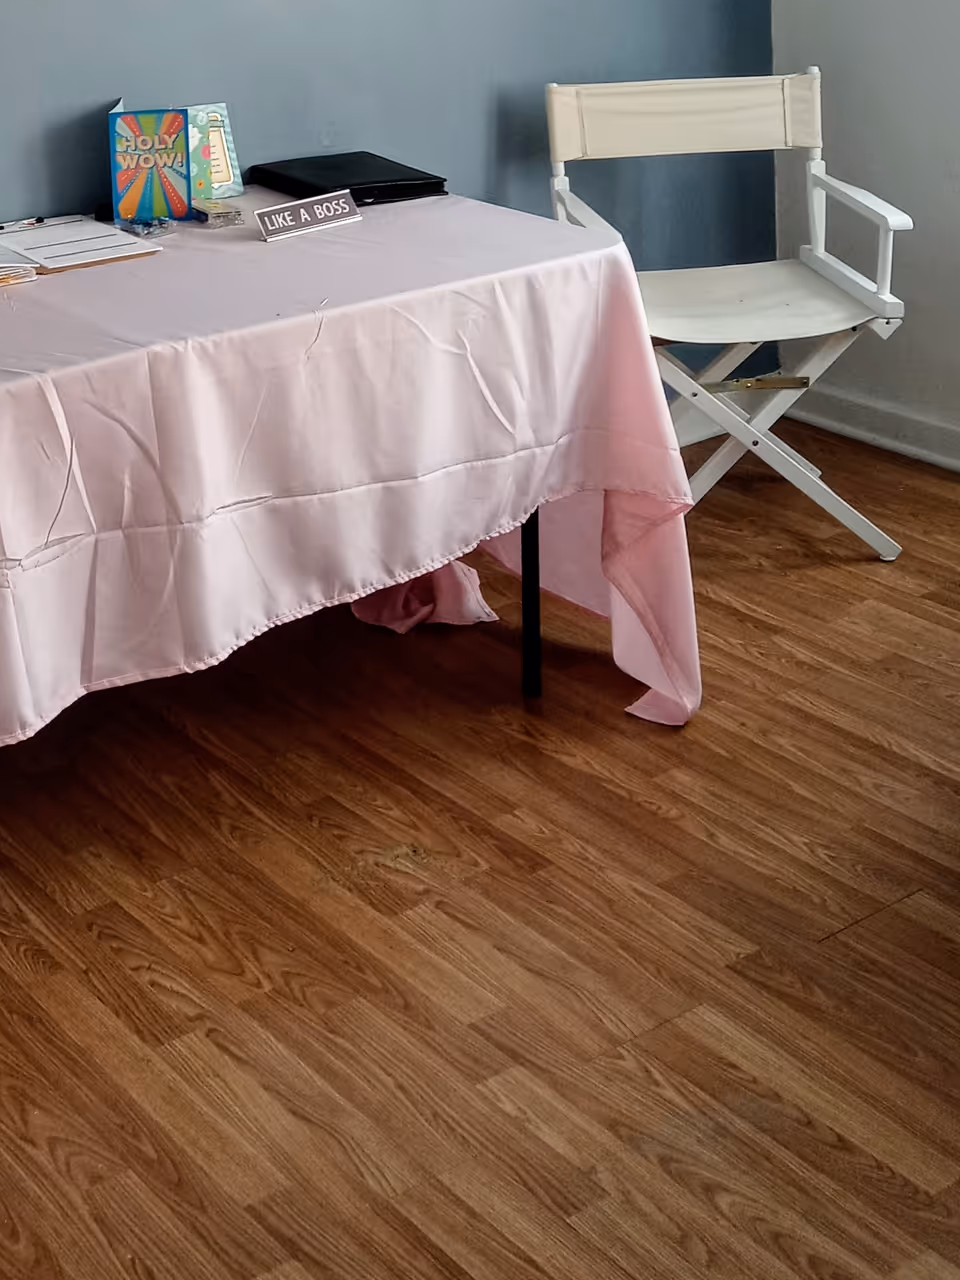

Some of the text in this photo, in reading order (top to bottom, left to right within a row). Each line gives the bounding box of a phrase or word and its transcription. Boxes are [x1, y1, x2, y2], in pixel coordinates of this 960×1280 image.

[121, 133, 179, 152] HOLY
[117, 151, 185, 170] WOW!
[263, 198, 350, 231] LIKE A BOSS
